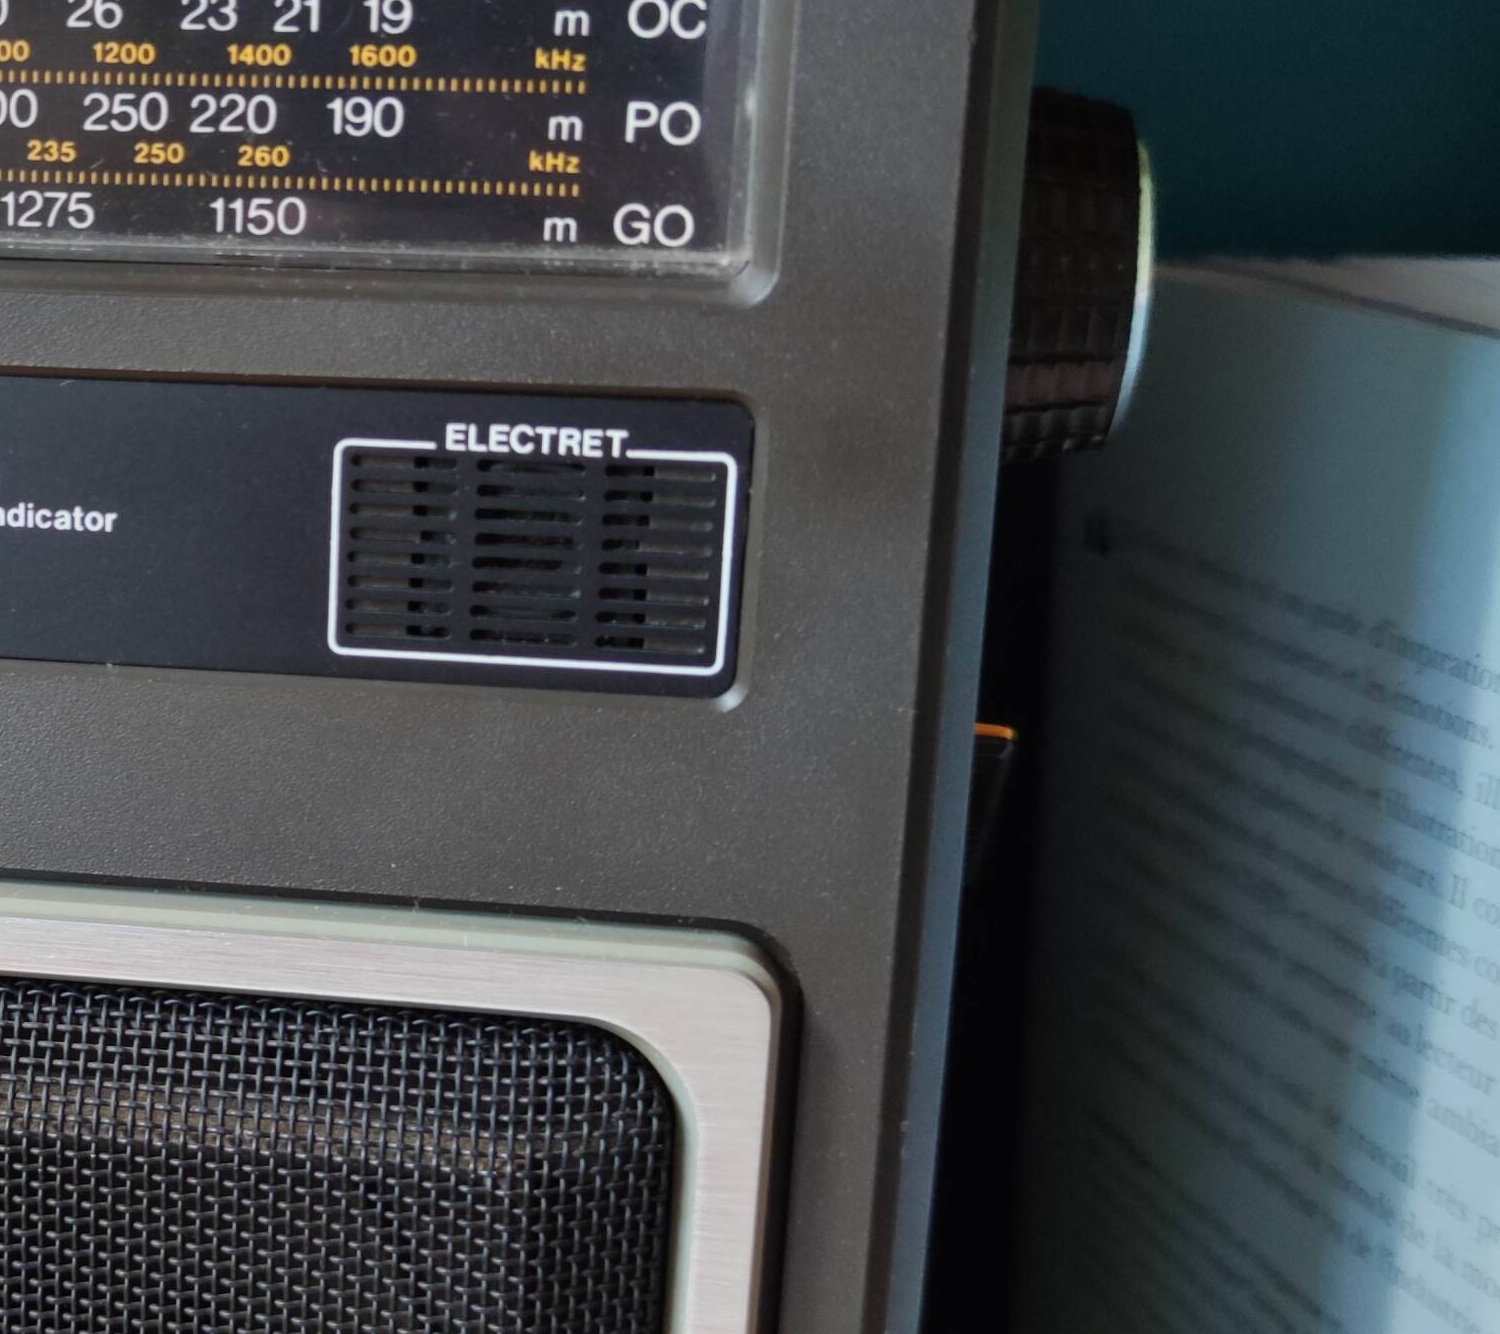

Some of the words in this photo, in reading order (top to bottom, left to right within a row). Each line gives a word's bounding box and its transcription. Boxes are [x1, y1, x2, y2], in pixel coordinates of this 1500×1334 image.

[554, 9, 590, 37] m
[92, 42, 156, 65] 1200
[227, 44, 291, 66] 1400
[349, 45, 417, 67] 1600
[535, 48, 587, 72] kHz
[83, 91, 169, 133] 250
[189, 94, 277, 135] 220
[326, 97, 404, 138] 190
[548, 114, 583, 142] m
[624, 101, 701, 146] PO
[27, 140, 77, 163] 235
[134, 142, 185, 165] 250
[238, 145, 290, 167] 260
[529, 151, 580, 175] kHz
[0, 190, 95, 230] 1275
[208, 196, 307, 236] 1150
[542, 215, 577, 243] m
[613, 203, 695, 247] GO
[444, 422, 631, 460] ELECTRET
